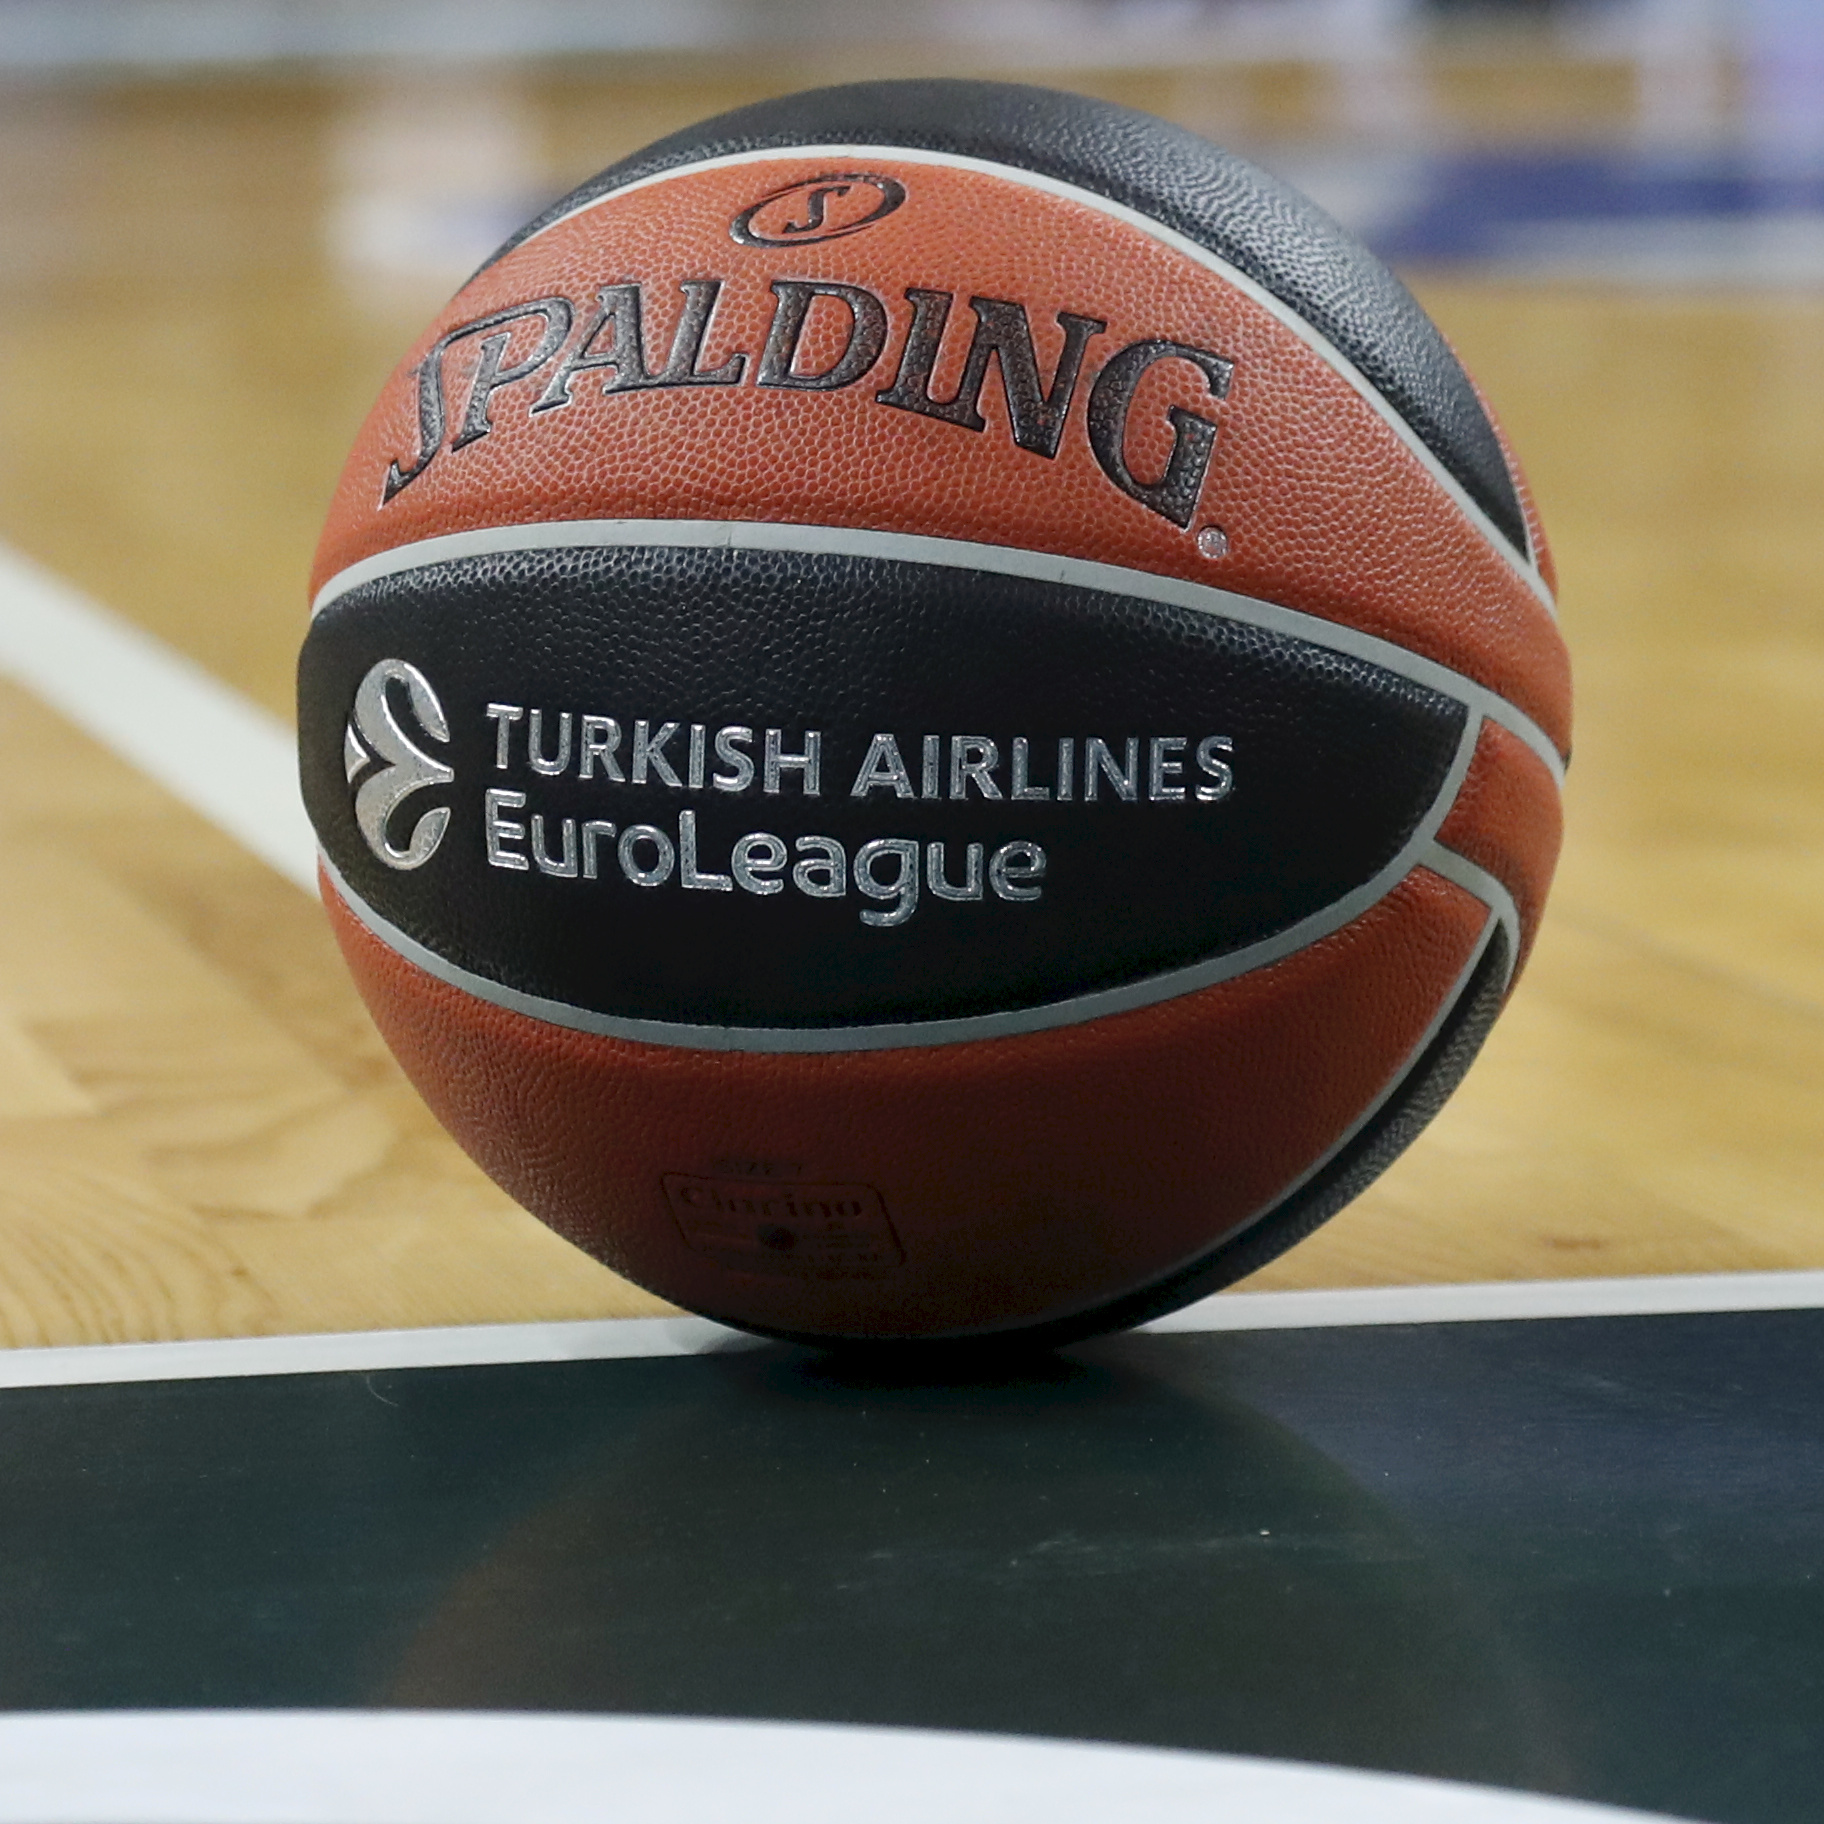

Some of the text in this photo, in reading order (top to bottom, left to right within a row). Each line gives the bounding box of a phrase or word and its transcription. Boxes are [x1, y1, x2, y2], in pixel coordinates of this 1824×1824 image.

[382, 279, 1235, 530] SPALDING
[484, 702, 1236, 802] TURKISH AIRLINES
[485, 790, 1046, 926] EuroLeague
